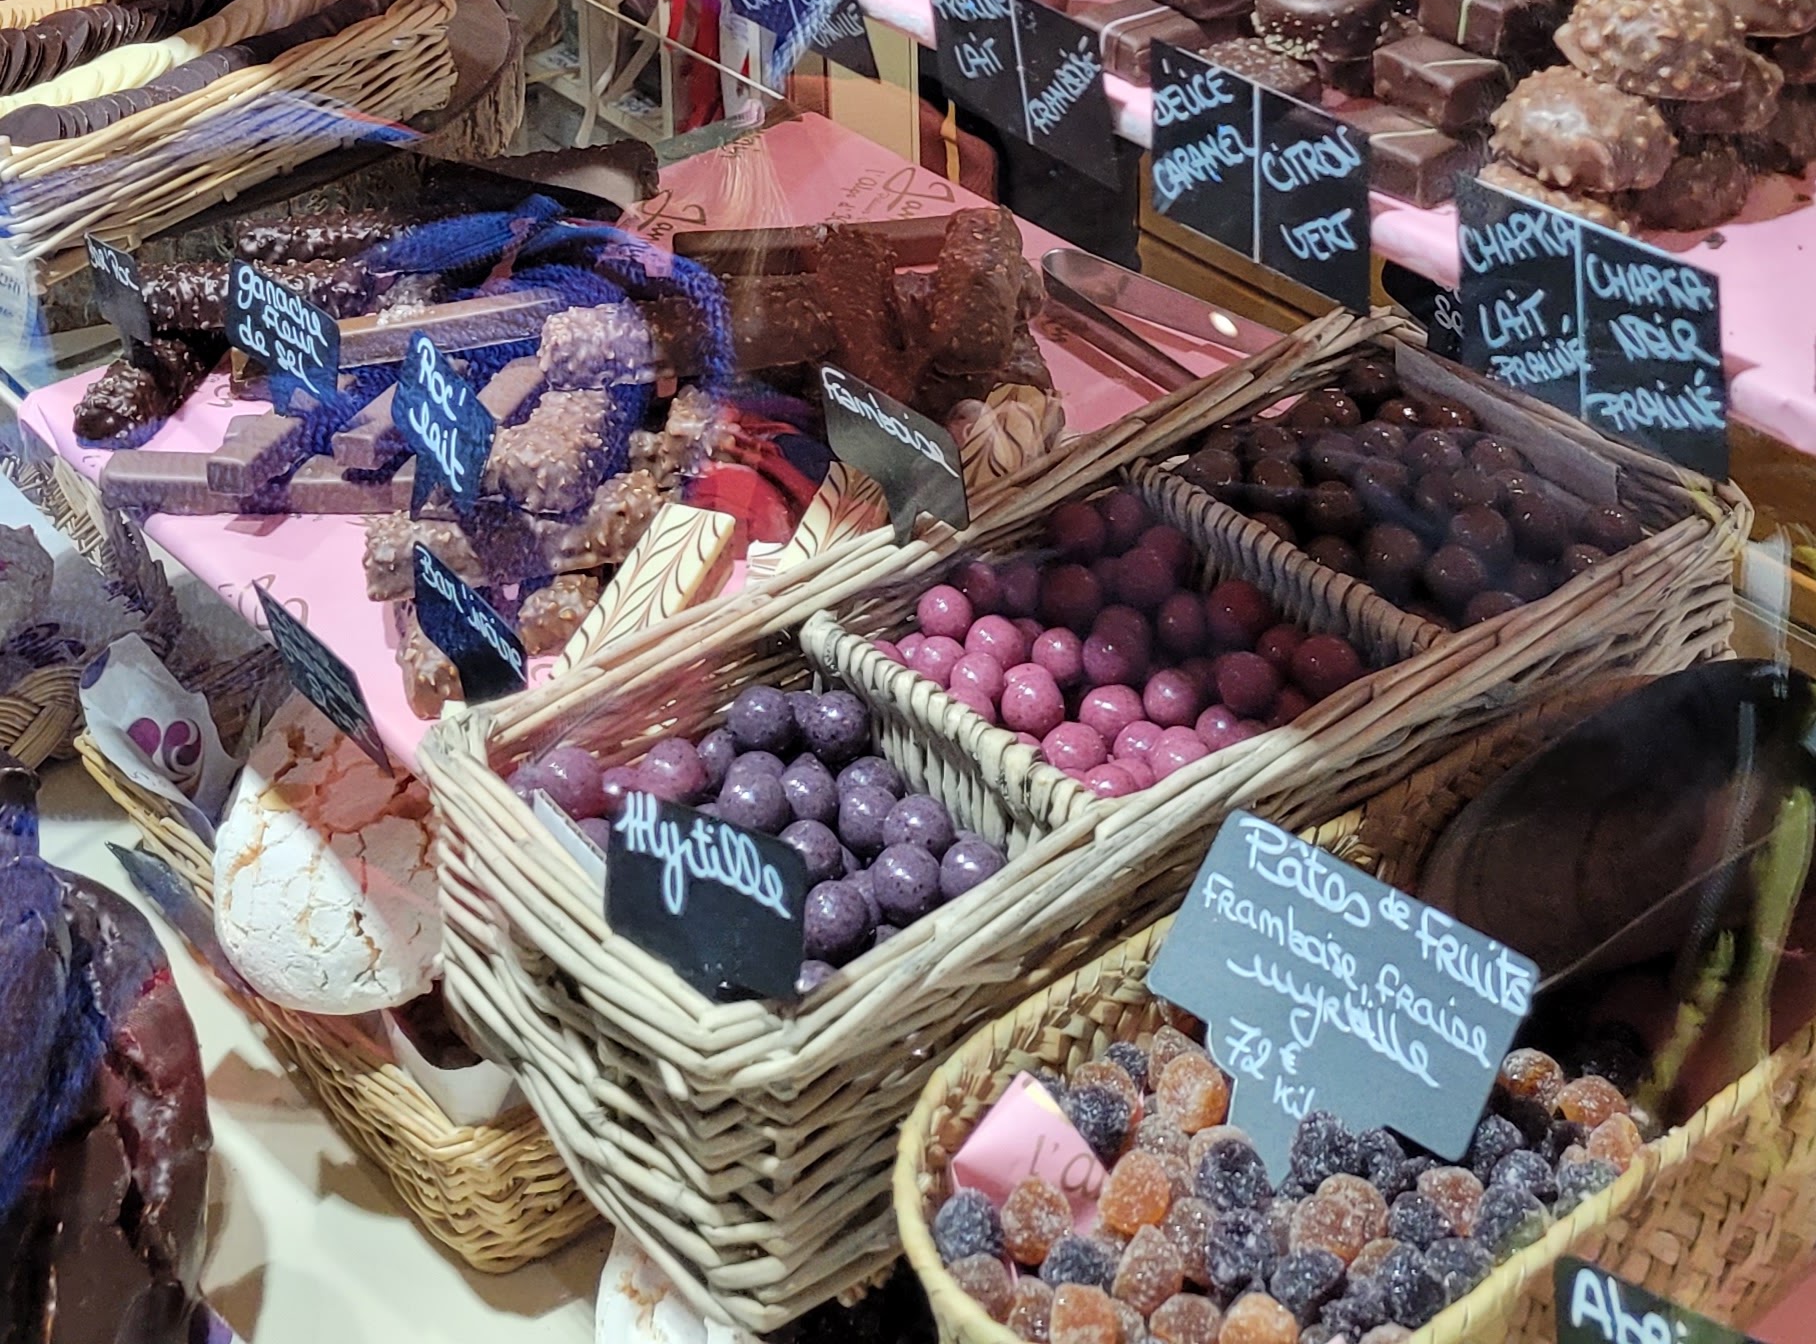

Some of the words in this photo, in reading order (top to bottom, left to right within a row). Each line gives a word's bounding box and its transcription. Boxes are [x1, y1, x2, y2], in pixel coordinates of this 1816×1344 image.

[954, 31, 1005, 80] LAIT
[1029, 36, 1103, 136] FRAMBOISE
[1152, 123, 1257, 200] CARAMEL
[1261, 123, 1364, 193] CITRON
[1281, 207, 1359, 263] VERT
[1459, 212, 1580, 275] CHAPKA
[237, 264, 329, 348] ganache
[1480, 289, 1546, 349] LAIT
[1584, 252, 1716, 313] CHAPKA
[238, 314, 271, 358] de
[275, 339, 321, 395] sel
[1493, 313, 1593, 386] PRALINÉ
[1609, 311, 1721, 368] NOIR
[1586, 372, 1727, 433] PRALINÉ
[408, 400, 465, 493] lait
[614, 790, 793, 920] Myrtille
[1238, 816, 1371, 929] Pâtes
[1378, 887, 1411, 931] de
[1415, 905, 1533, 1017] Fruits
[1226, 954, 1440, 1090] myrtille
